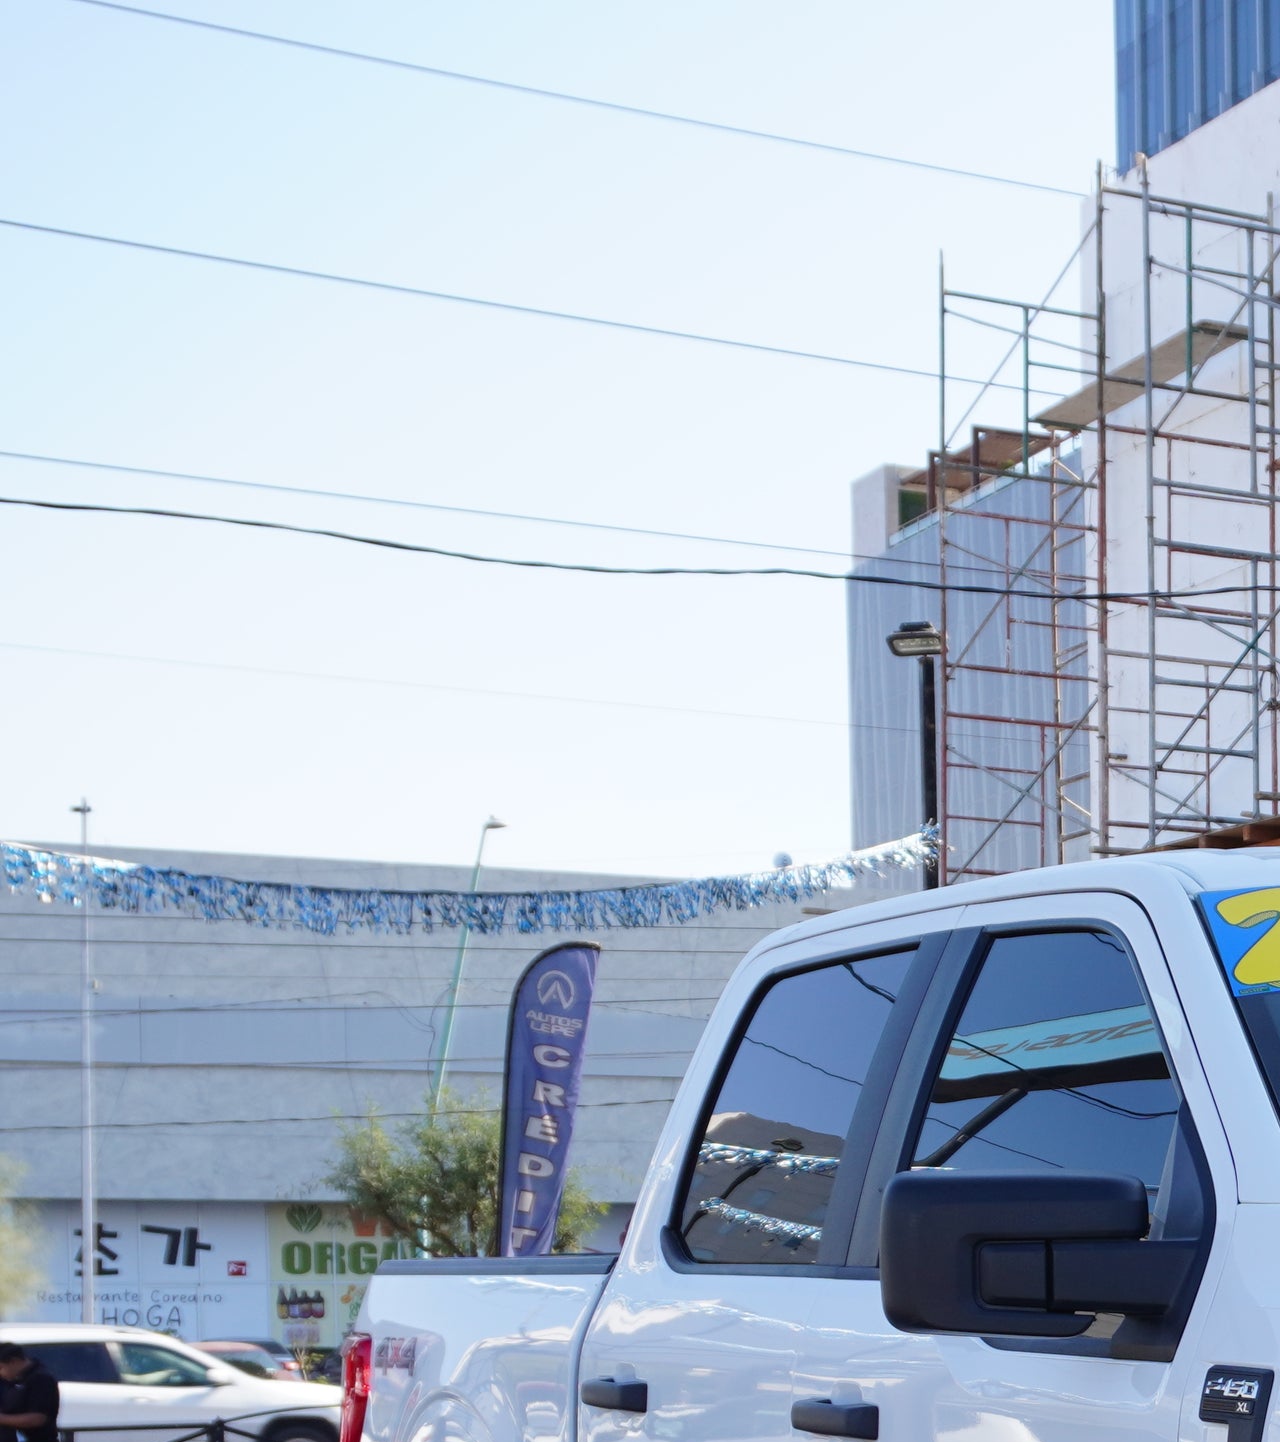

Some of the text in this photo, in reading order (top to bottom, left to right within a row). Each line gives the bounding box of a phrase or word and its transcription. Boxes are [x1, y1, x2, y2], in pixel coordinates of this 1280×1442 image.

[526, 1009, 583, 1029] AUTOS
[530, 1020, 576, 1038] LEPE
[37, 1287, 223, 1304] Restarante Coreano
[1236, 1402, 1249, 1413] XL
